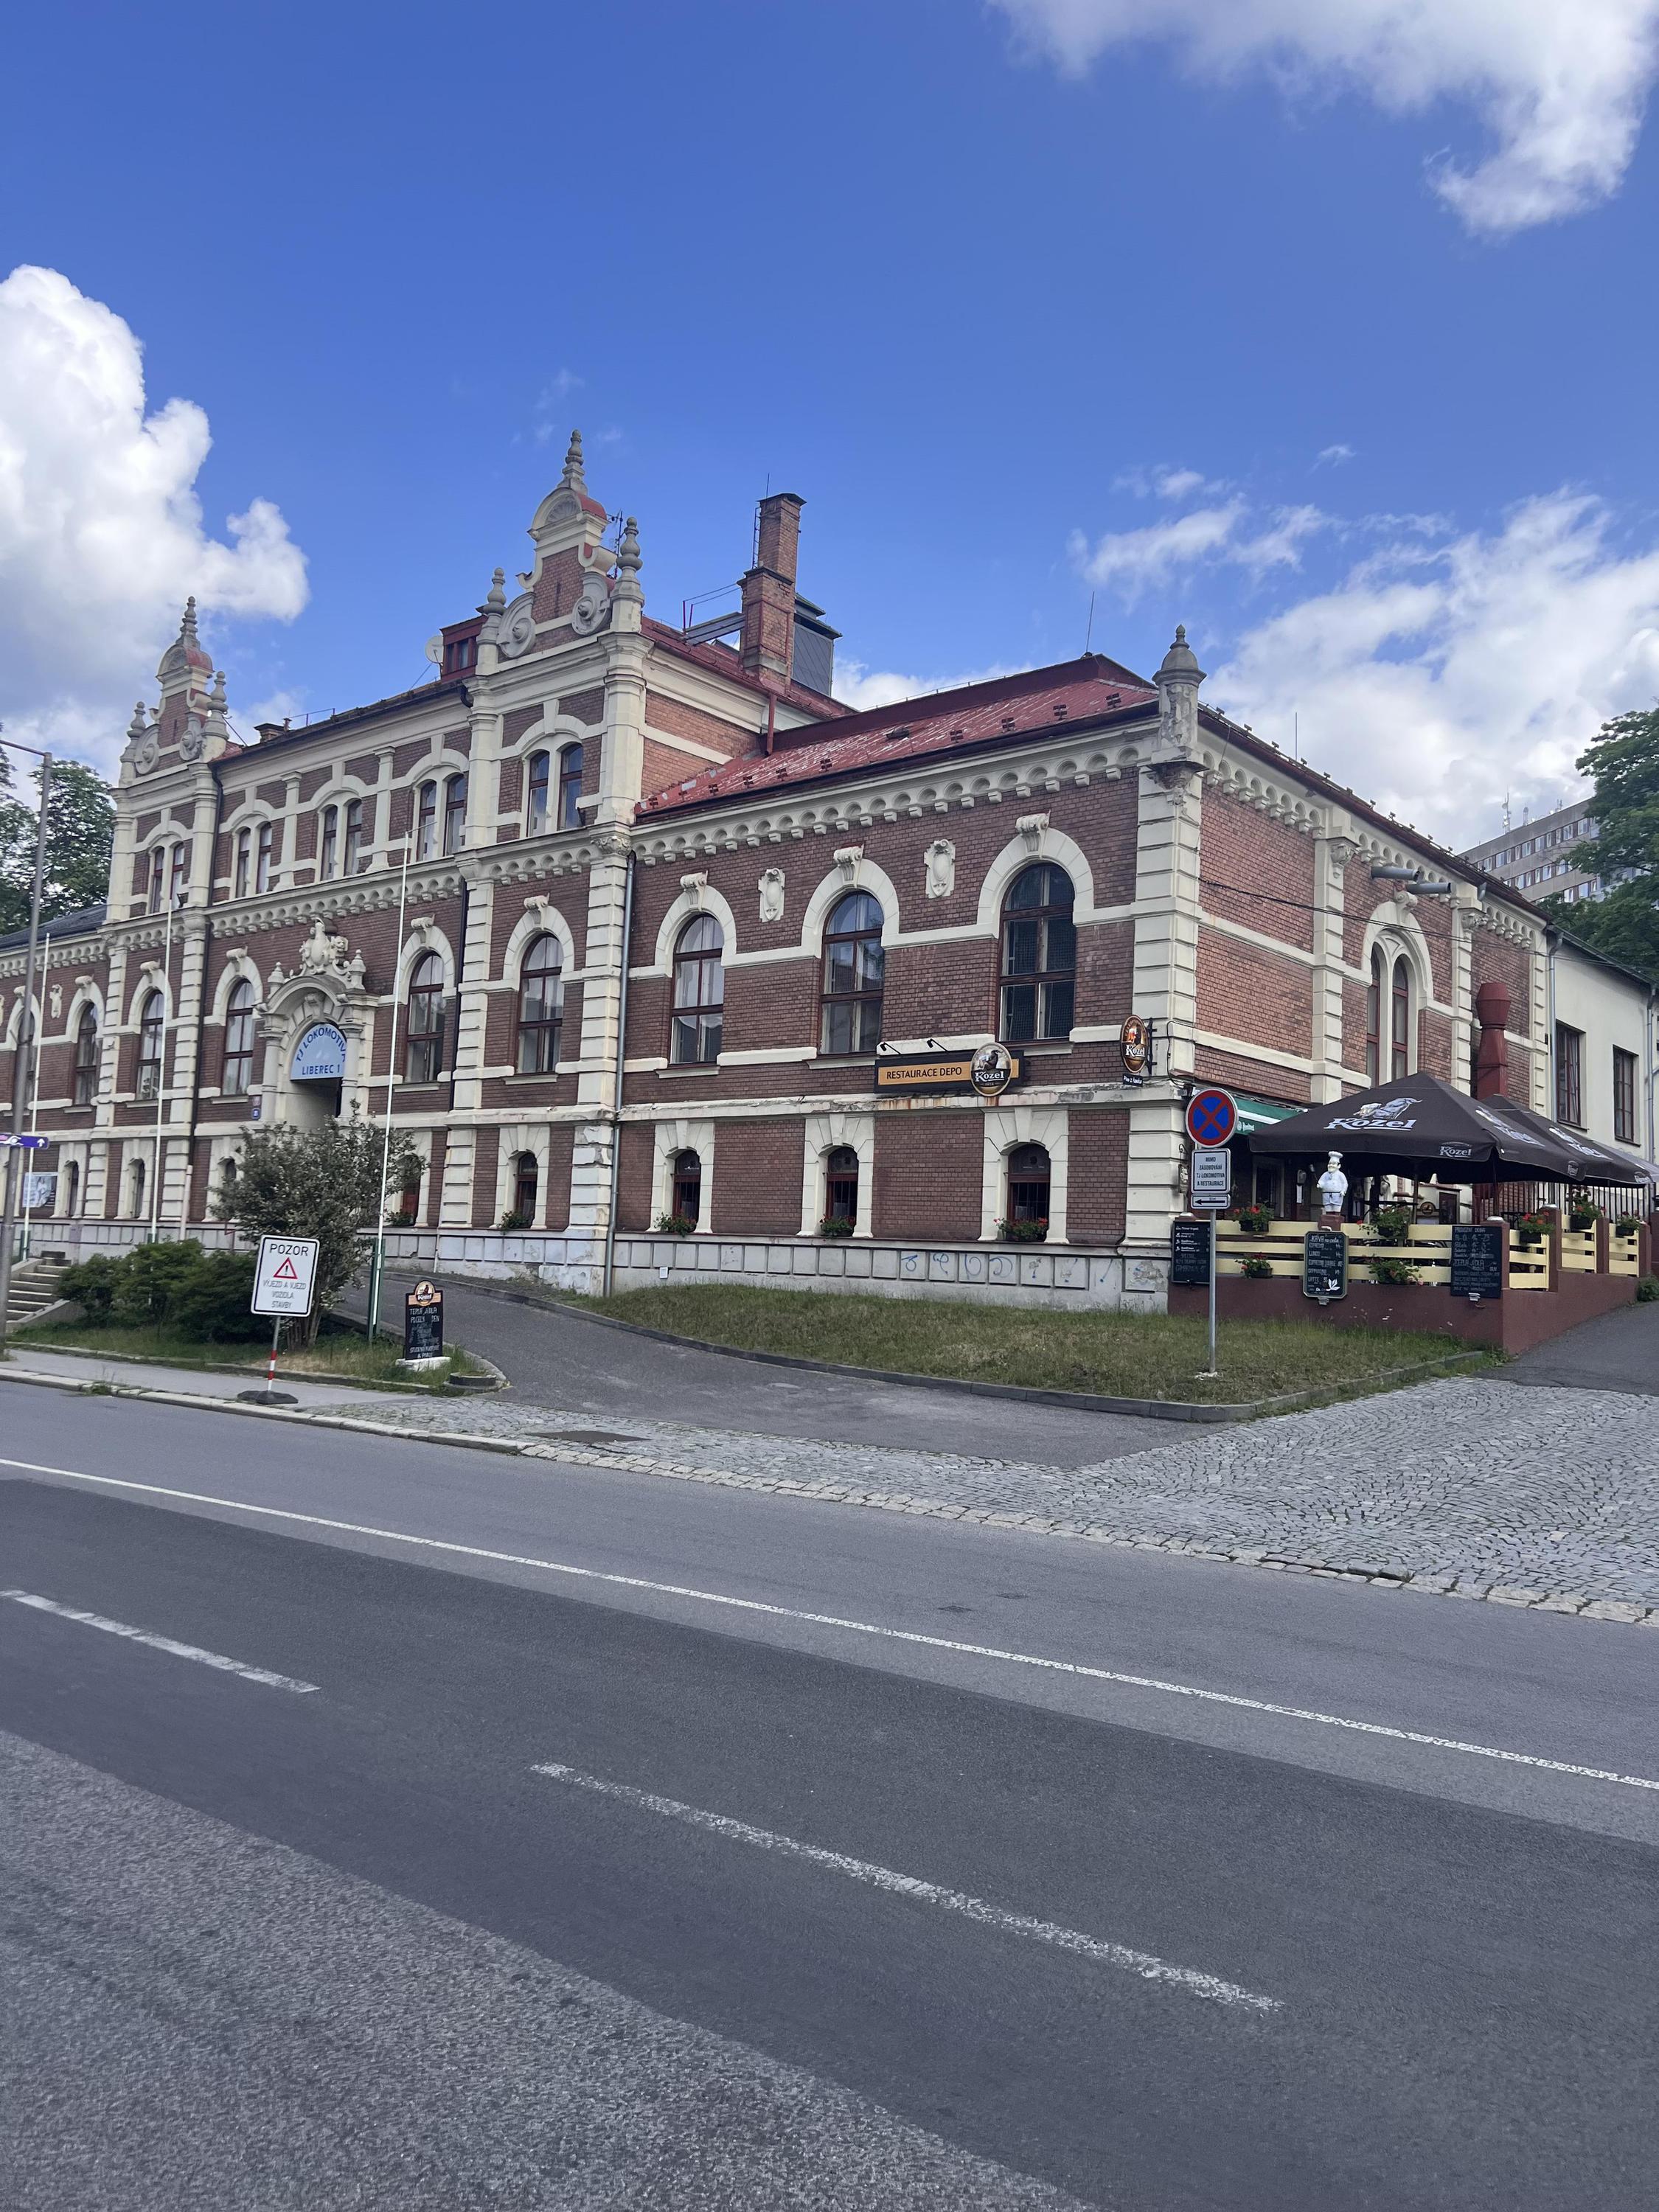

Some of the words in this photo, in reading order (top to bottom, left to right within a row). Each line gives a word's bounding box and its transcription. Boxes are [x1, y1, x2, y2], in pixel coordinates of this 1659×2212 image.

[296, 1049, 304, 1062] TJ
[1125, 1044, 1145, 1057] Kozel
[302, 1065, 334, 1075] LIBEREC
[886, 1068, 937, 1079] RESTAURACE
[940, 1066, 962, 1076] DEPO
[974, 1071, 1005, 1082] Kozel
[1323, 1118, 1417, 1131] Kozel
[1439, 1146, 1472, 1158] Kozel
[270, 1243, 309, 1256] POZOR
[271, 1301, 292, 1309] STAVBY
